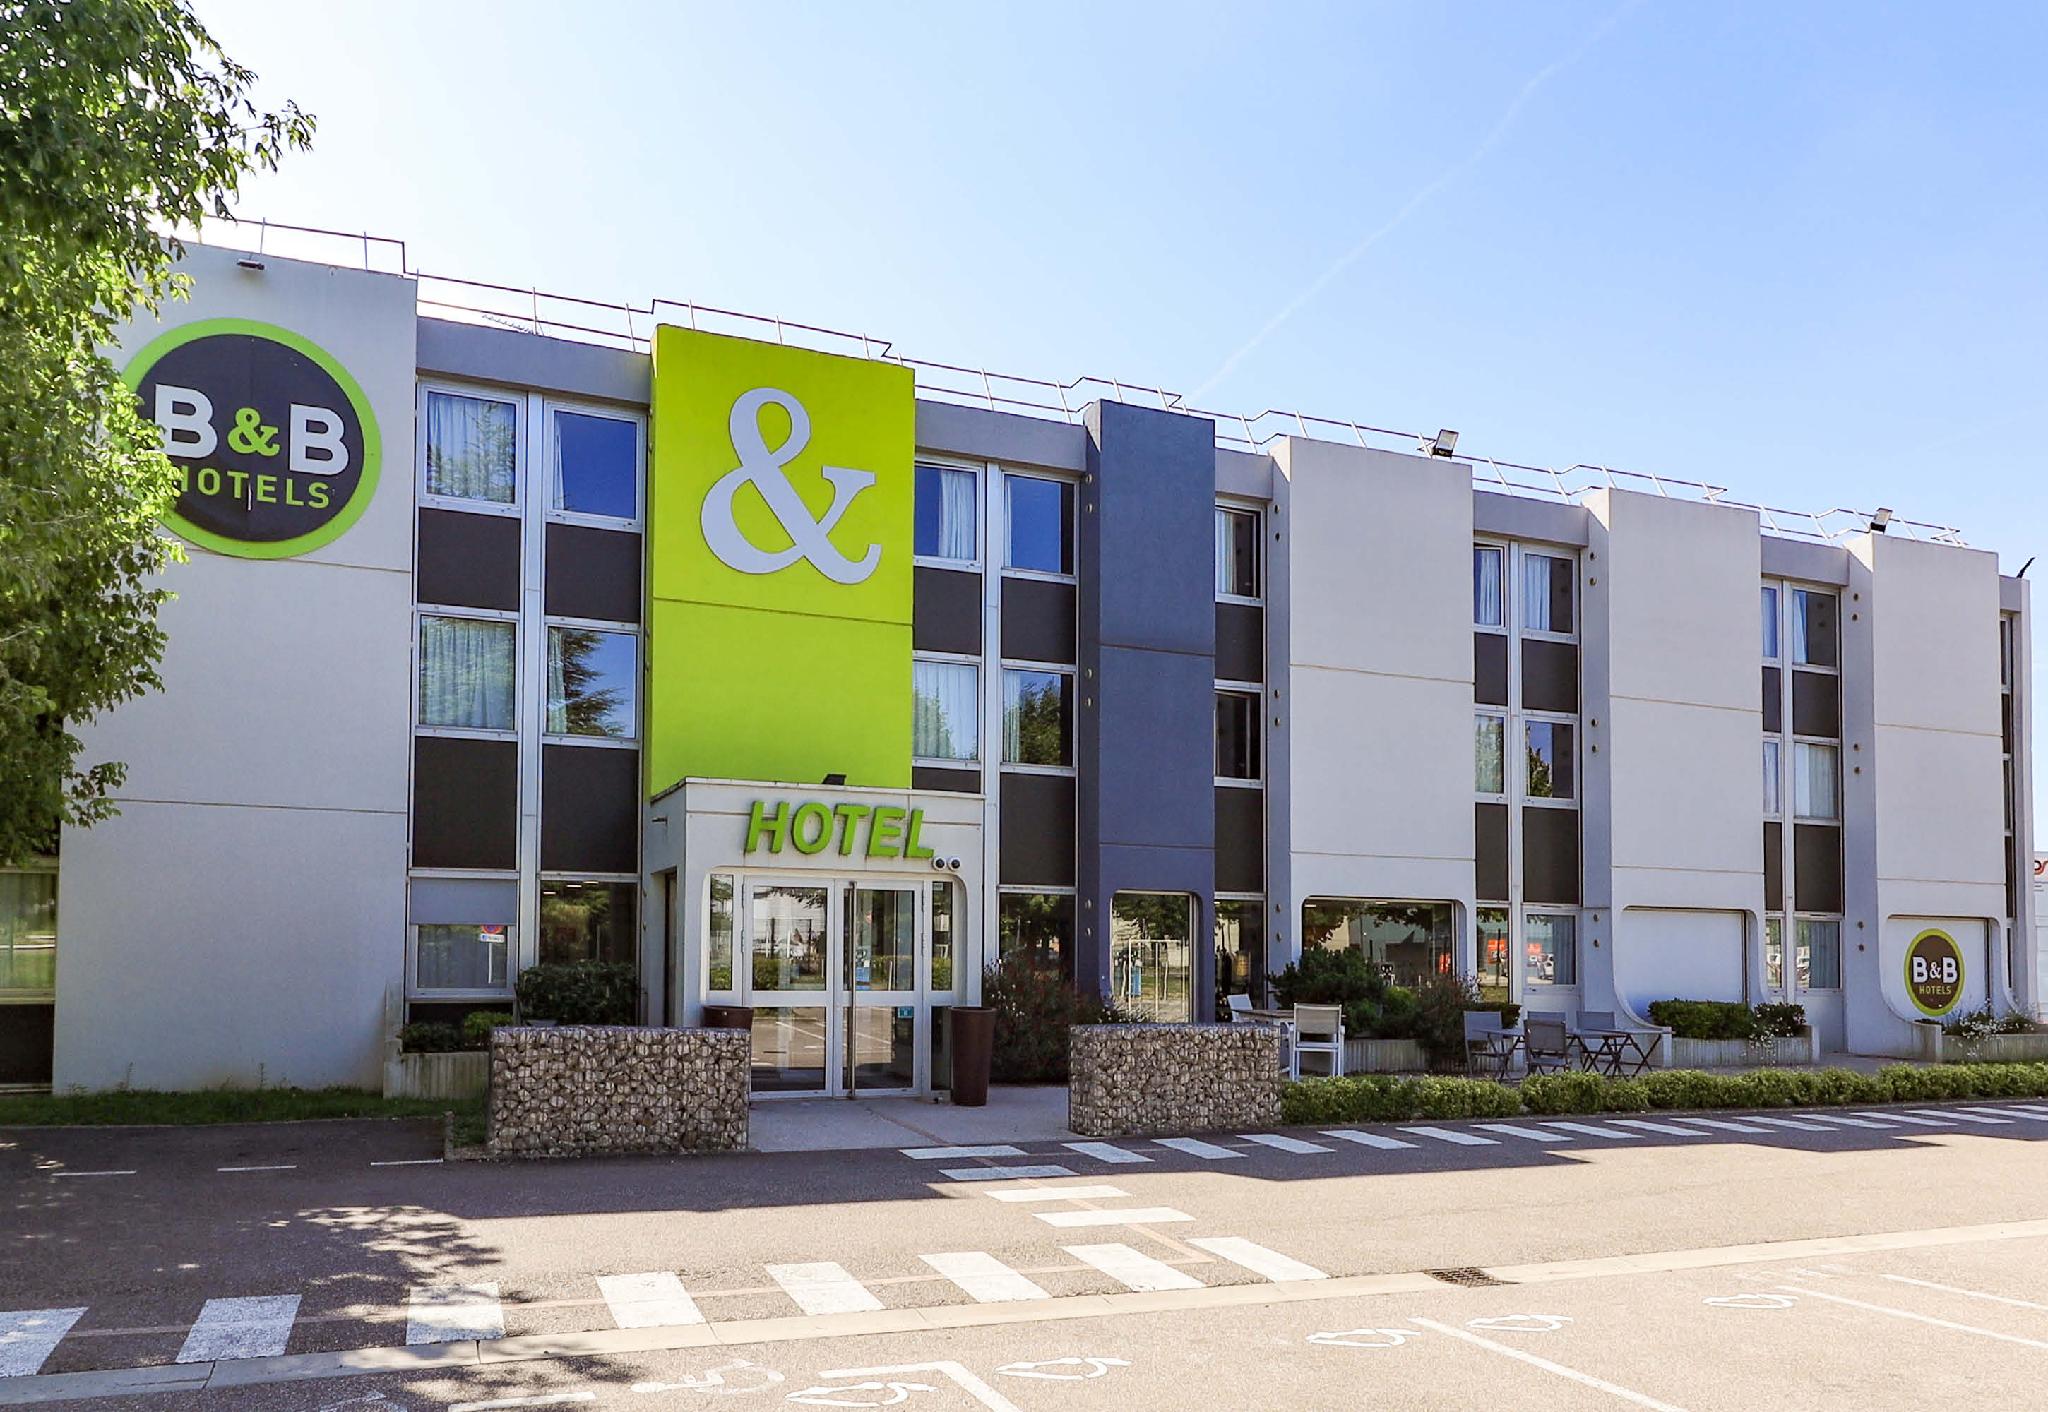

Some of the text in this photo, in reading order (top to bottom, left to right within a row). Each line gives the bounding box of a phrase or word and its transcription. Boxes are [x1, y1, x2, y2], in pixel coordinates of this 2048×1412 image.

[700, 387, 881, 584] &
[744, 801, 934, 858] HOTEL
[1919, 985, 1952, 995] HOTELS
